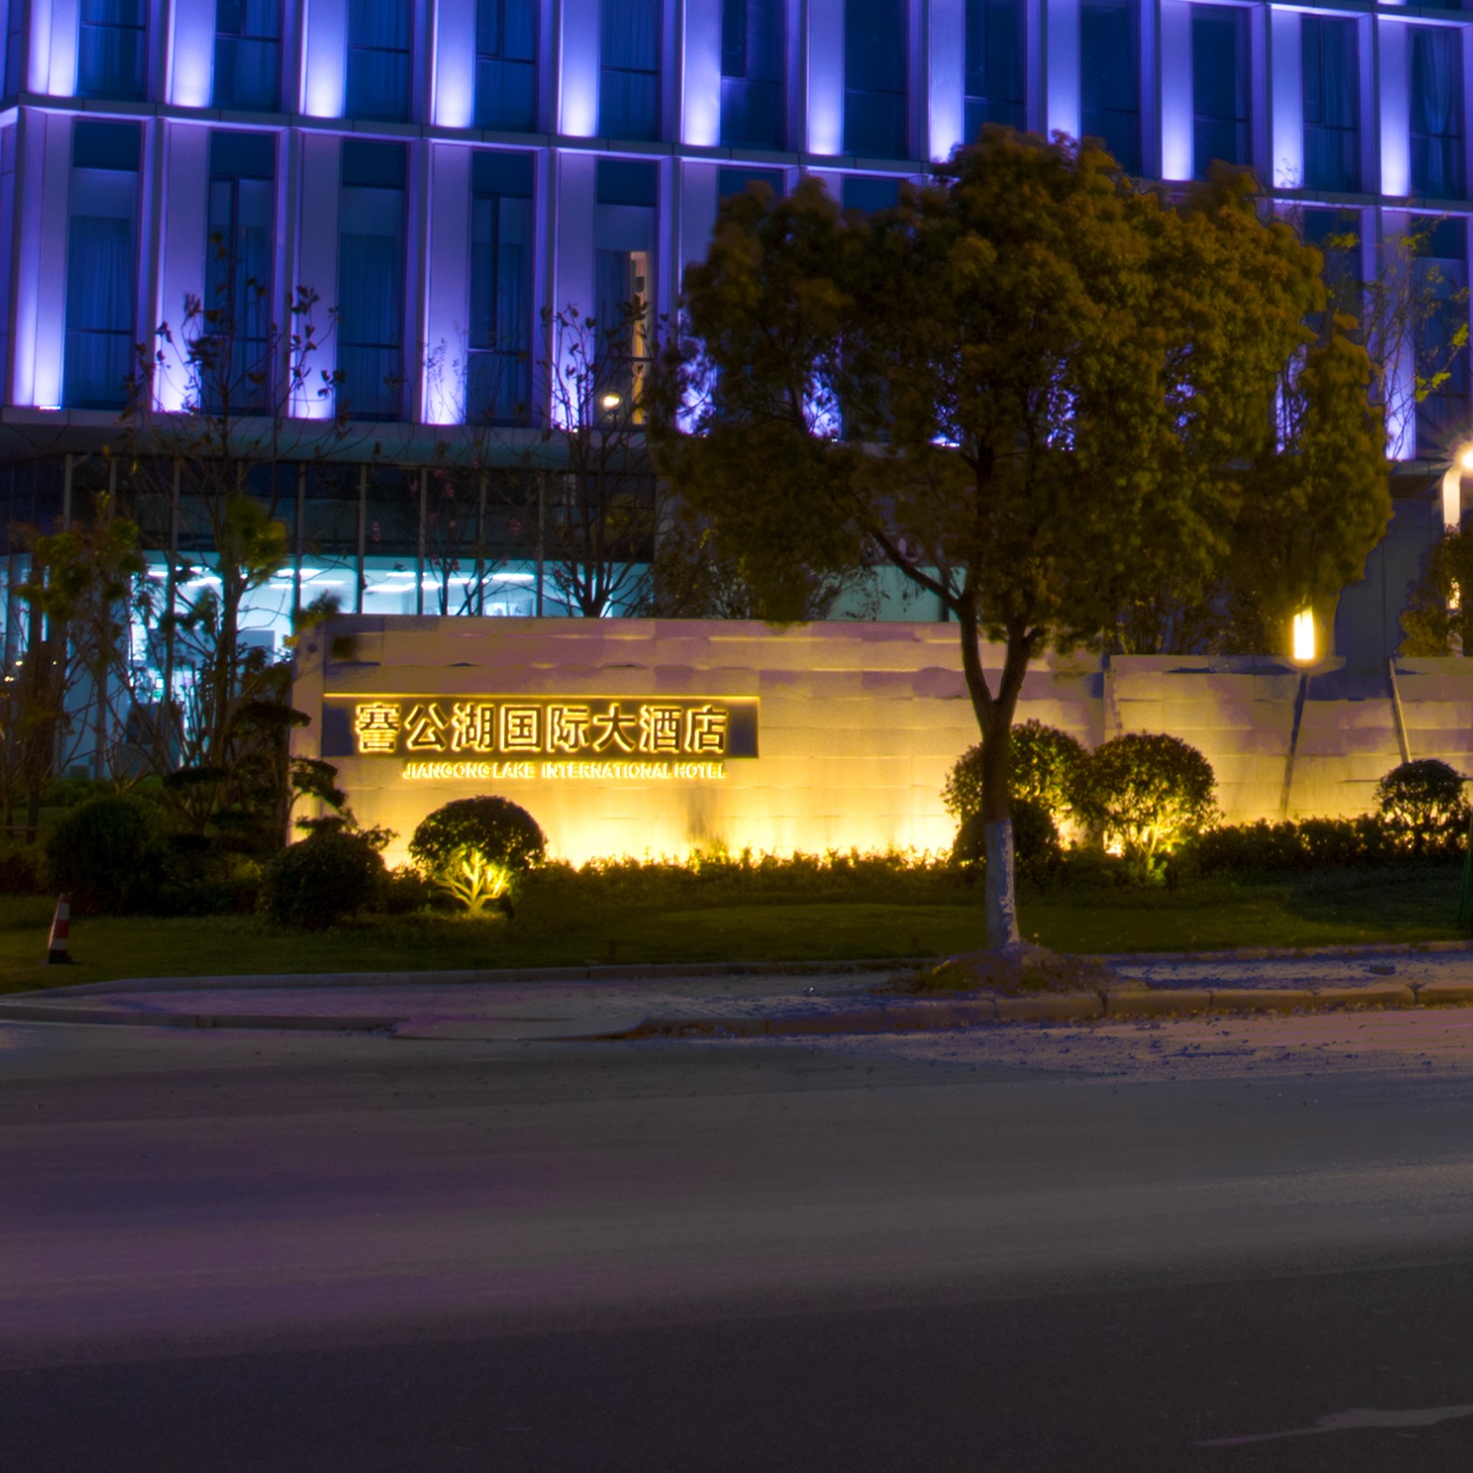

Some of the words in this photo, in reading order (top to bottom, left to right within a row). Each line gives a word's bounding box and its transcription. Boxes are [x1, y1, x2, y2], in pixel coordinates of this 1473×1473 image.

[402, 762, 491, 780] JIANGONG
[492, 762, 536, 780] LAKE
[540, 762, 672, 780] INTERNATIONAL
[674, 762, 728, 780] HOTEL
